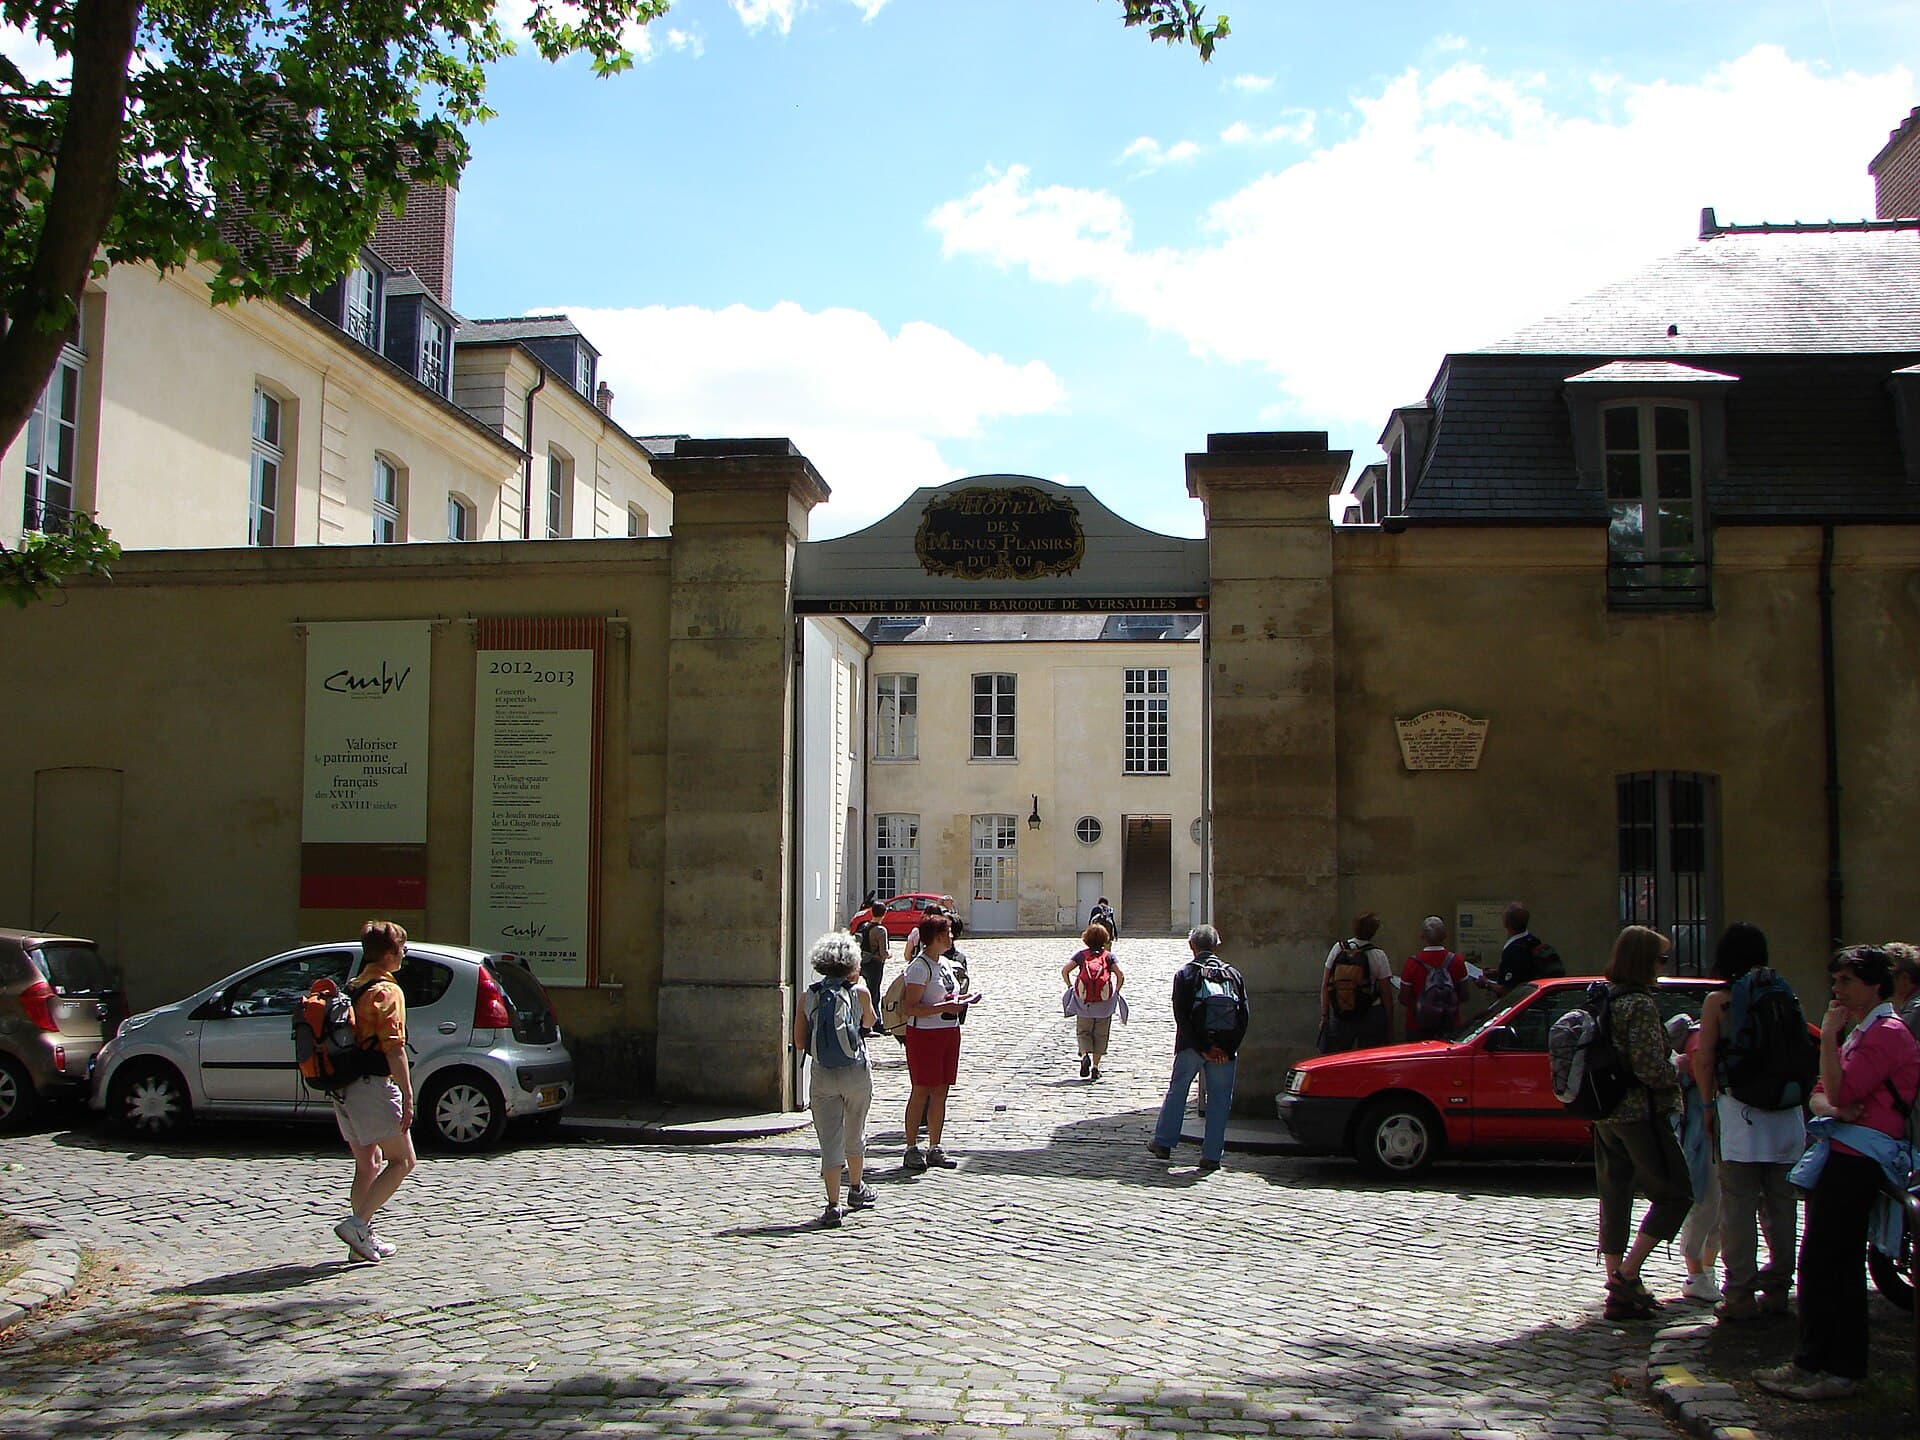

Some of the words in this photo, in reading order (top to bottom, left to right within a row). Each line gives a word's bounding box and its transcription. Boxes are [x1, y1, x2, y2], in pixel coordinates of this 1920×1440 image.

[987, 521, 1021, 533] DES
[927, 532, 996, 550] MENUS
[1003, 534, 1073, 550] PLAISIRS
[968, 556, 991, 567] DU
[996, 551, 1032, 567] ROI
[829, 602, 886, 612] CENTRE
[894, 601, 912, 611] DE
[920, 601, 982, 611] MUSIQUE
[989, 600, 1055, 611] BAROQUE
[1062, 599, 1080, 610] DE
[1087, 599, 1177, 610] VERSAILLES
[489, 662, 533, 674] 2012
[533, 671, 574, 687] 2013
[495, 687, 526, 696] Concerts
[502, 696, 537, 704] spectacles
[346, 738, 398, 750] Valoriser
[323, 750, 389, 766] patrimoine
[363, 762, 408, 775] musical
[333, 775, 379, 789] français
[493, 774, 504, 782] Les
[492, 782, 518, 790] Violons
[520, 782, 528, 790] du
[530, 782, 540, 790] roi
[315, 790, 328, 799] des
[331, 802, 339, 810] et
[492, 811, 504, 819] Les
[505, 811, 527, 819] Jeudis
[528, 811, 560, 819] musicaux
[491, 819, 500, 827] de
[502, 819, 508, 827] la
[510, 820, 539, 828] Chapelle
[541, 820, 562, 828] royale
[491, 848, 503, 856] Les
[504, 848, 543, 857] Rencontres
[490, 882, 525, 891] Colloques
